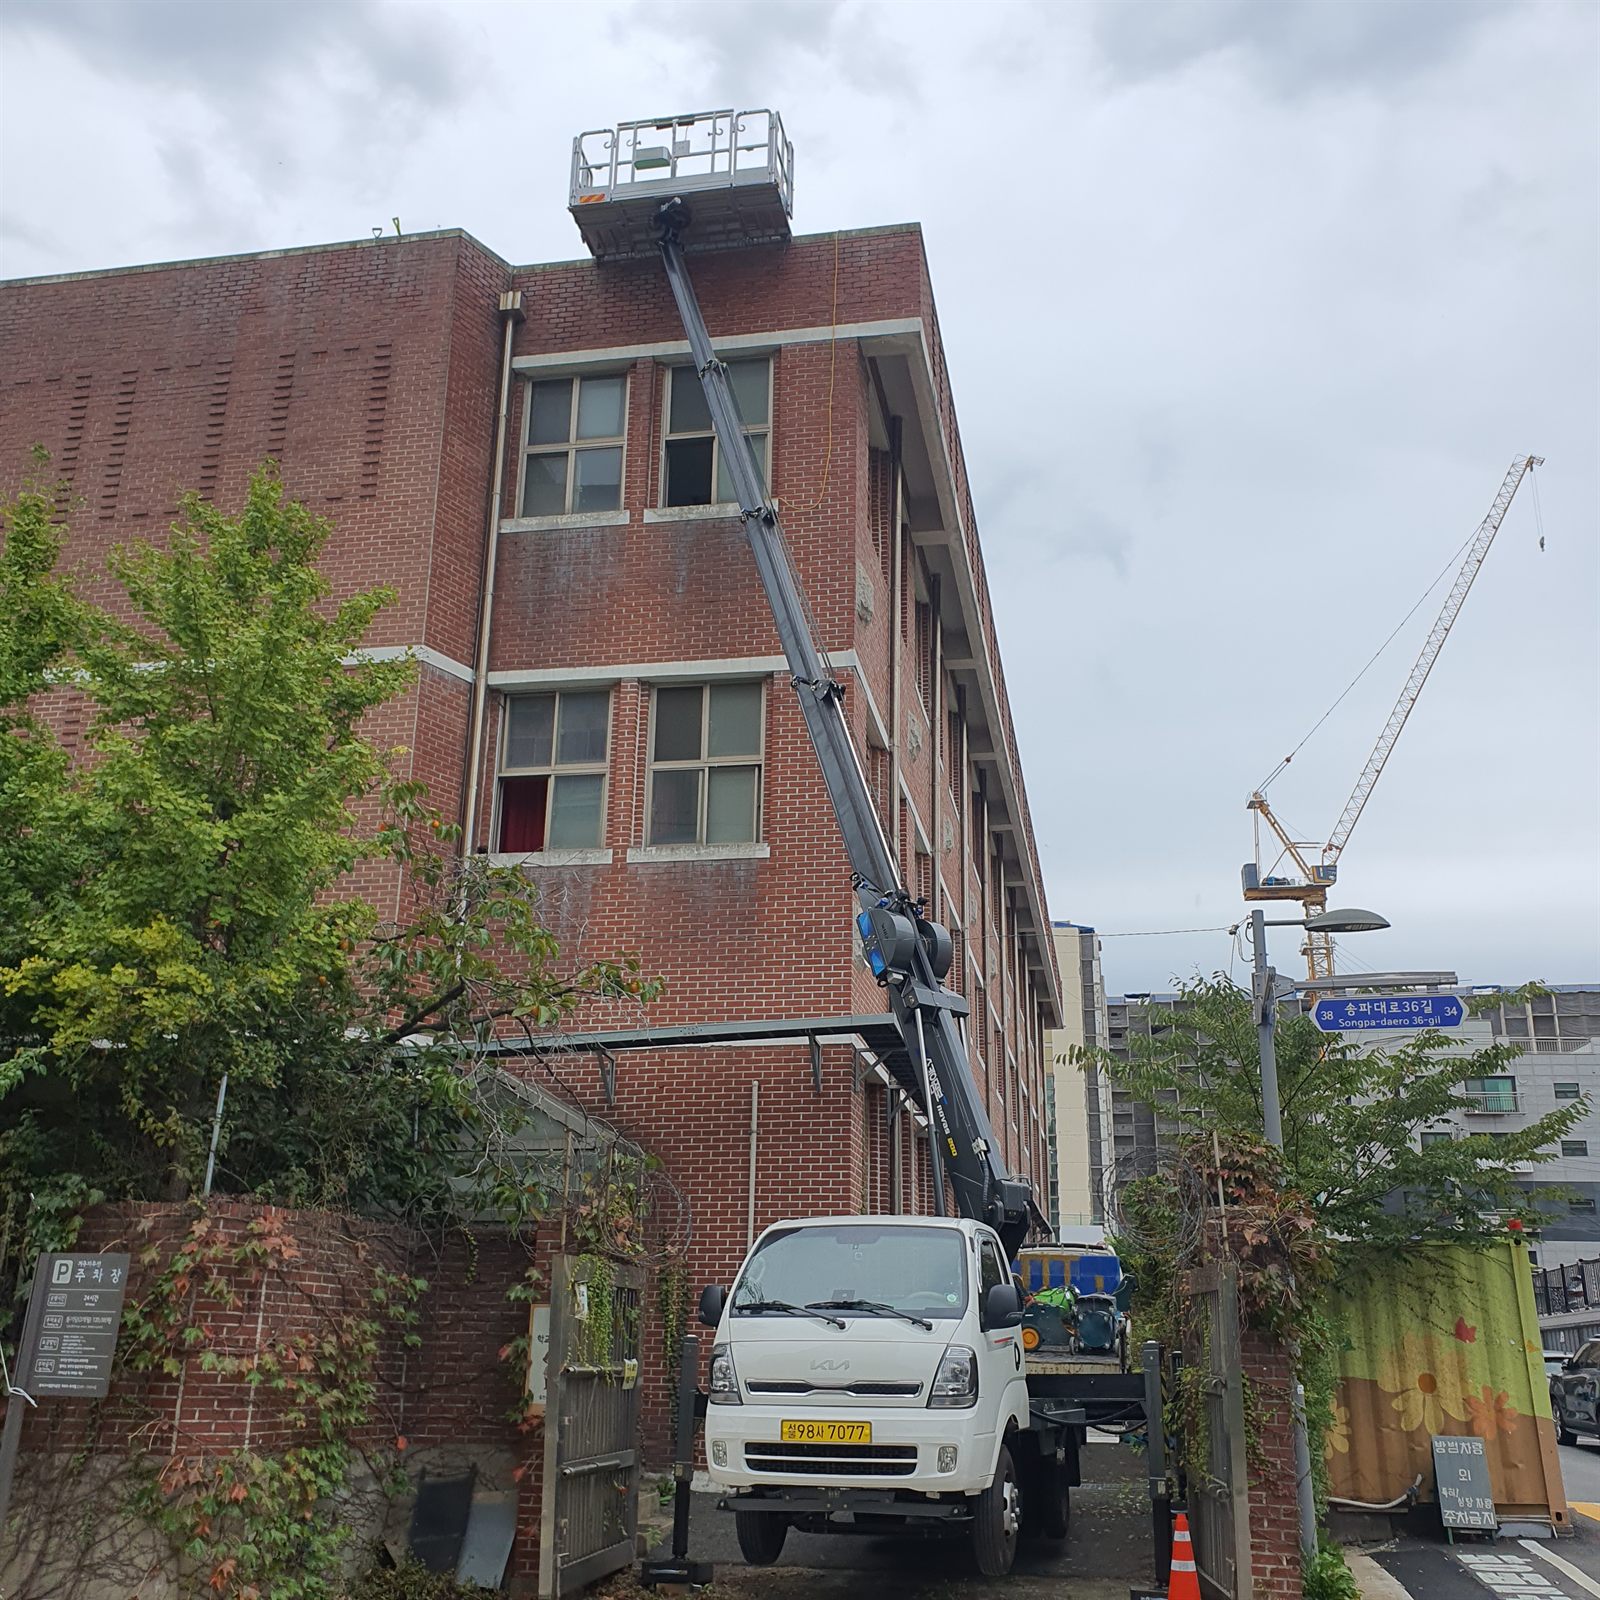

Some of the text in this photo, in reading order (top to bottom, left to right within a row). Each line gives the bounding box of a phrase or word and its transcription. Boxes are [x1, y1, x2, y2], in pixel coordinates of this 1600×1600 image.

[1344, 1000, 1433, 1016] 송파대로36길
[1444, 1006, 1458, 1017] 34
[1320, 1011, 1334, 1021] 38
[1338, 1015, 1441, 1028] Songpa-daero 36-gil
[937, 1104, 950, 1135] novas
[827, 1424, 865, 1440] 7077
[1434, 1440, 1483, 1455] 방범차량
[1458, 1468, 1472, 1482] 외
[1475, 1497, 1493, 1509] 차량
[1443, 1509, 1495, 1525] 주차금지
